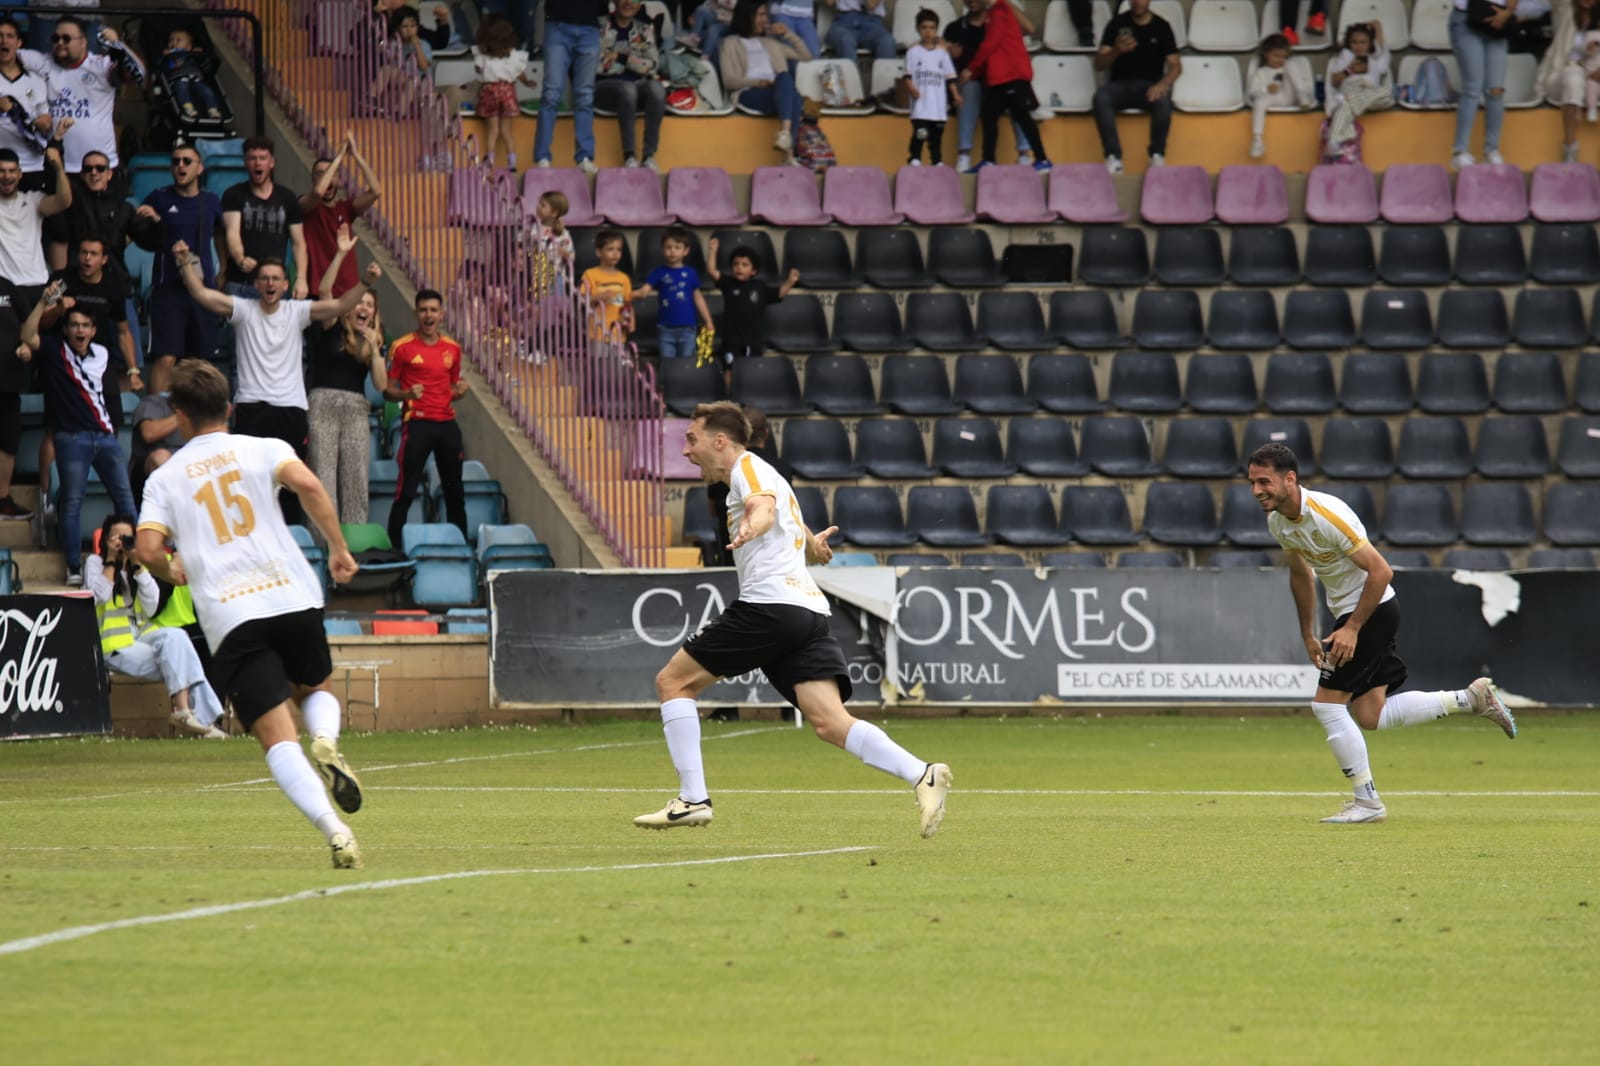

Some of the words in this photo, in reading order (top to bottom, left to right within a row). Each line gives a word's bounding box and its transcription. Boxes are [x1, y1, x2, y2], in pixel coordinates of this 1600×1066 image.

[184, 450, 239, 480] ESPINA
[192, 469, 256, 545] 15
[0, 607, 62, 714] ola
[896, 662, 1006, 685] NATURAL
[1097, 668, 1145, 689] CAFÉ
[1151, 672, 1176, 689] DE
